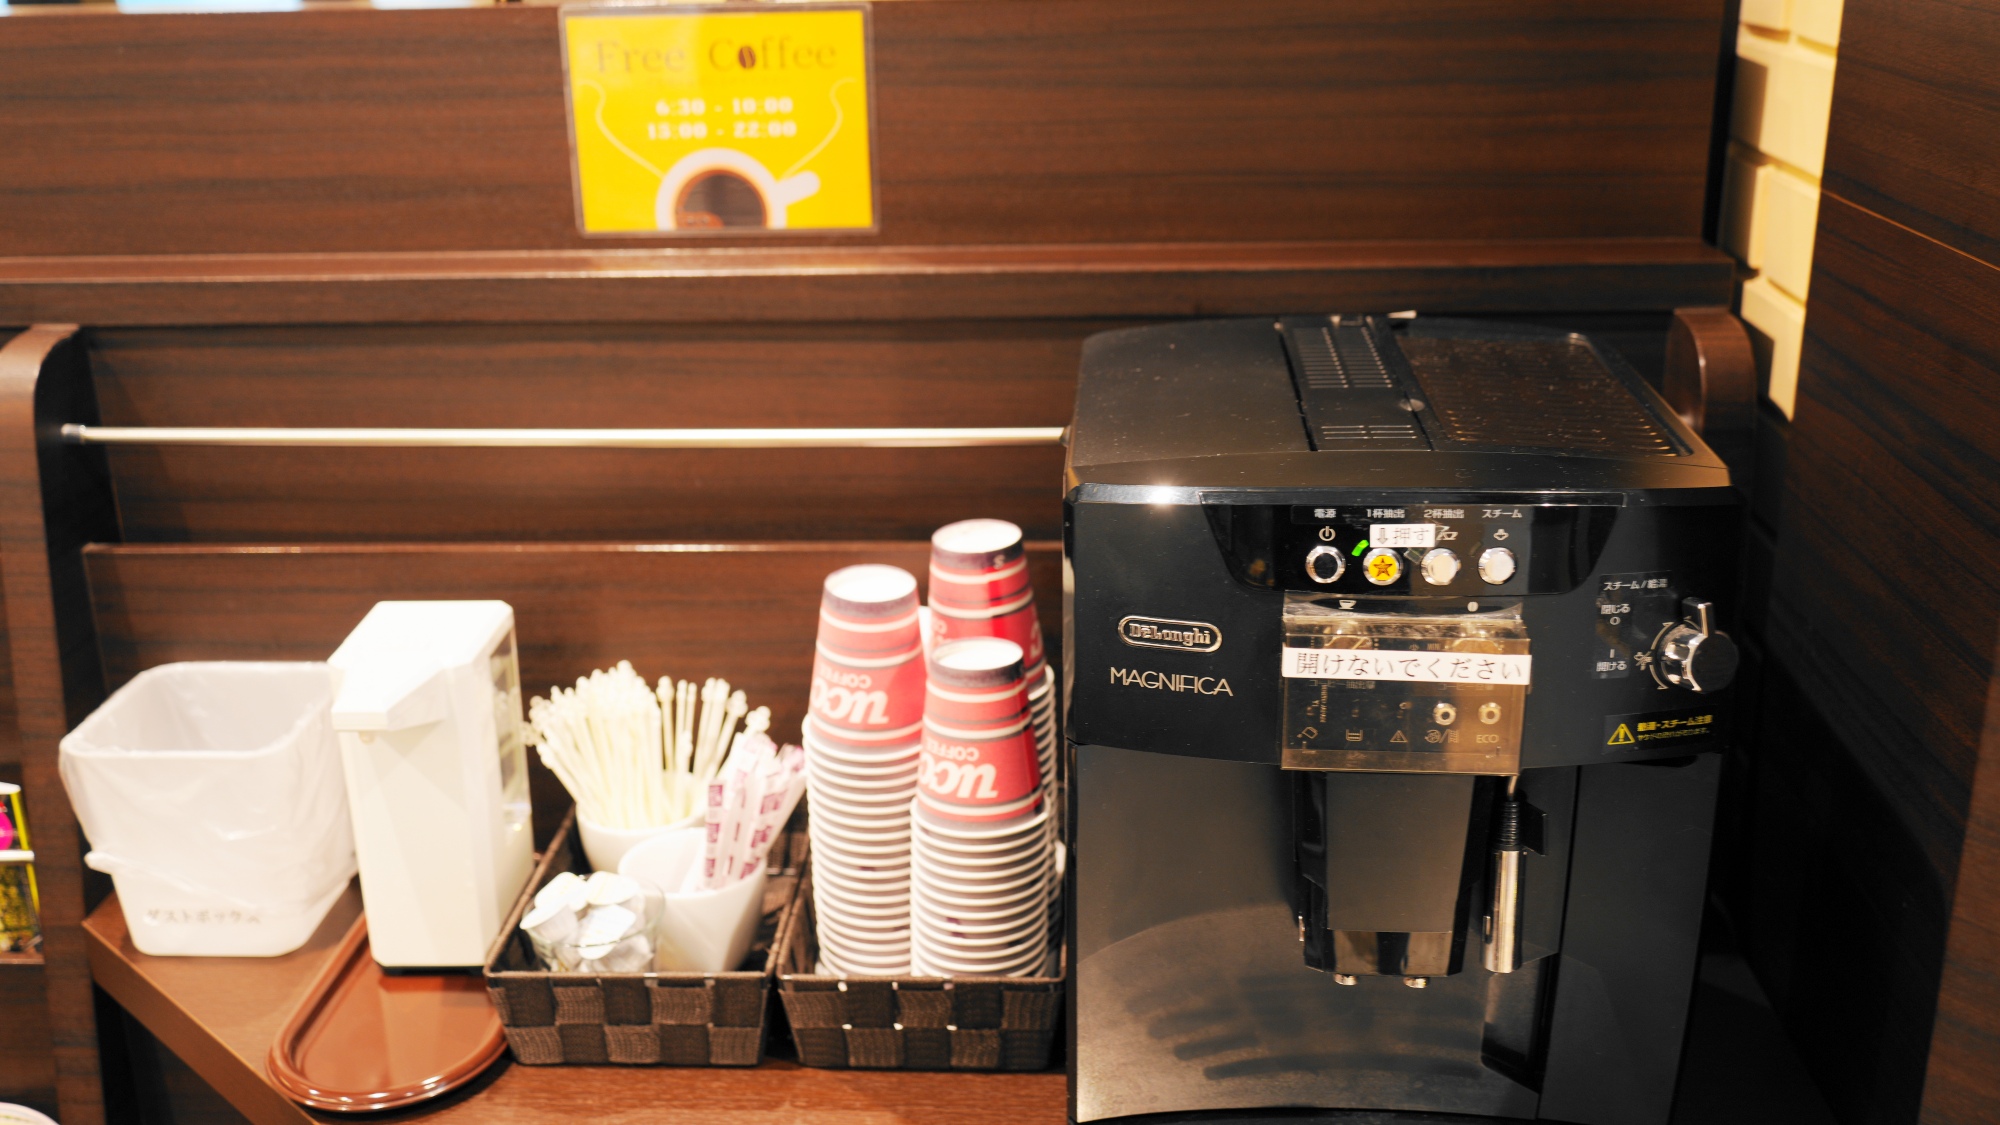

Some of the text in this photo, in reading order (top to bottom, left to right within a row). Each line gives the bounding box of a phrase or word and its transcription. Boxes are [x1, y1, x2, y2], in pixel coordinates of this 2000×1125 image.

[596, 39, 686, 75] Free
[655, 98, 706, 116] 6:30
[733, 120, 798, 138] 22:00
[1314, 508, 1337, 519] 電源
[1366, 508, 1405, 519] 1杯抽出
[1423, 508, 1465, 519] 2杯抽出
[1481, 509, 1522, 518] スチーム
[1393, 527, 1430, 545] 押す
[1296, 652, 1522, 680] 開けないでください
[1596, 660, 1627, 672] 開ける
[1110, 666, 1234, 697] MAGNIFICA
[1476, 734, 1499, 744] ECO
